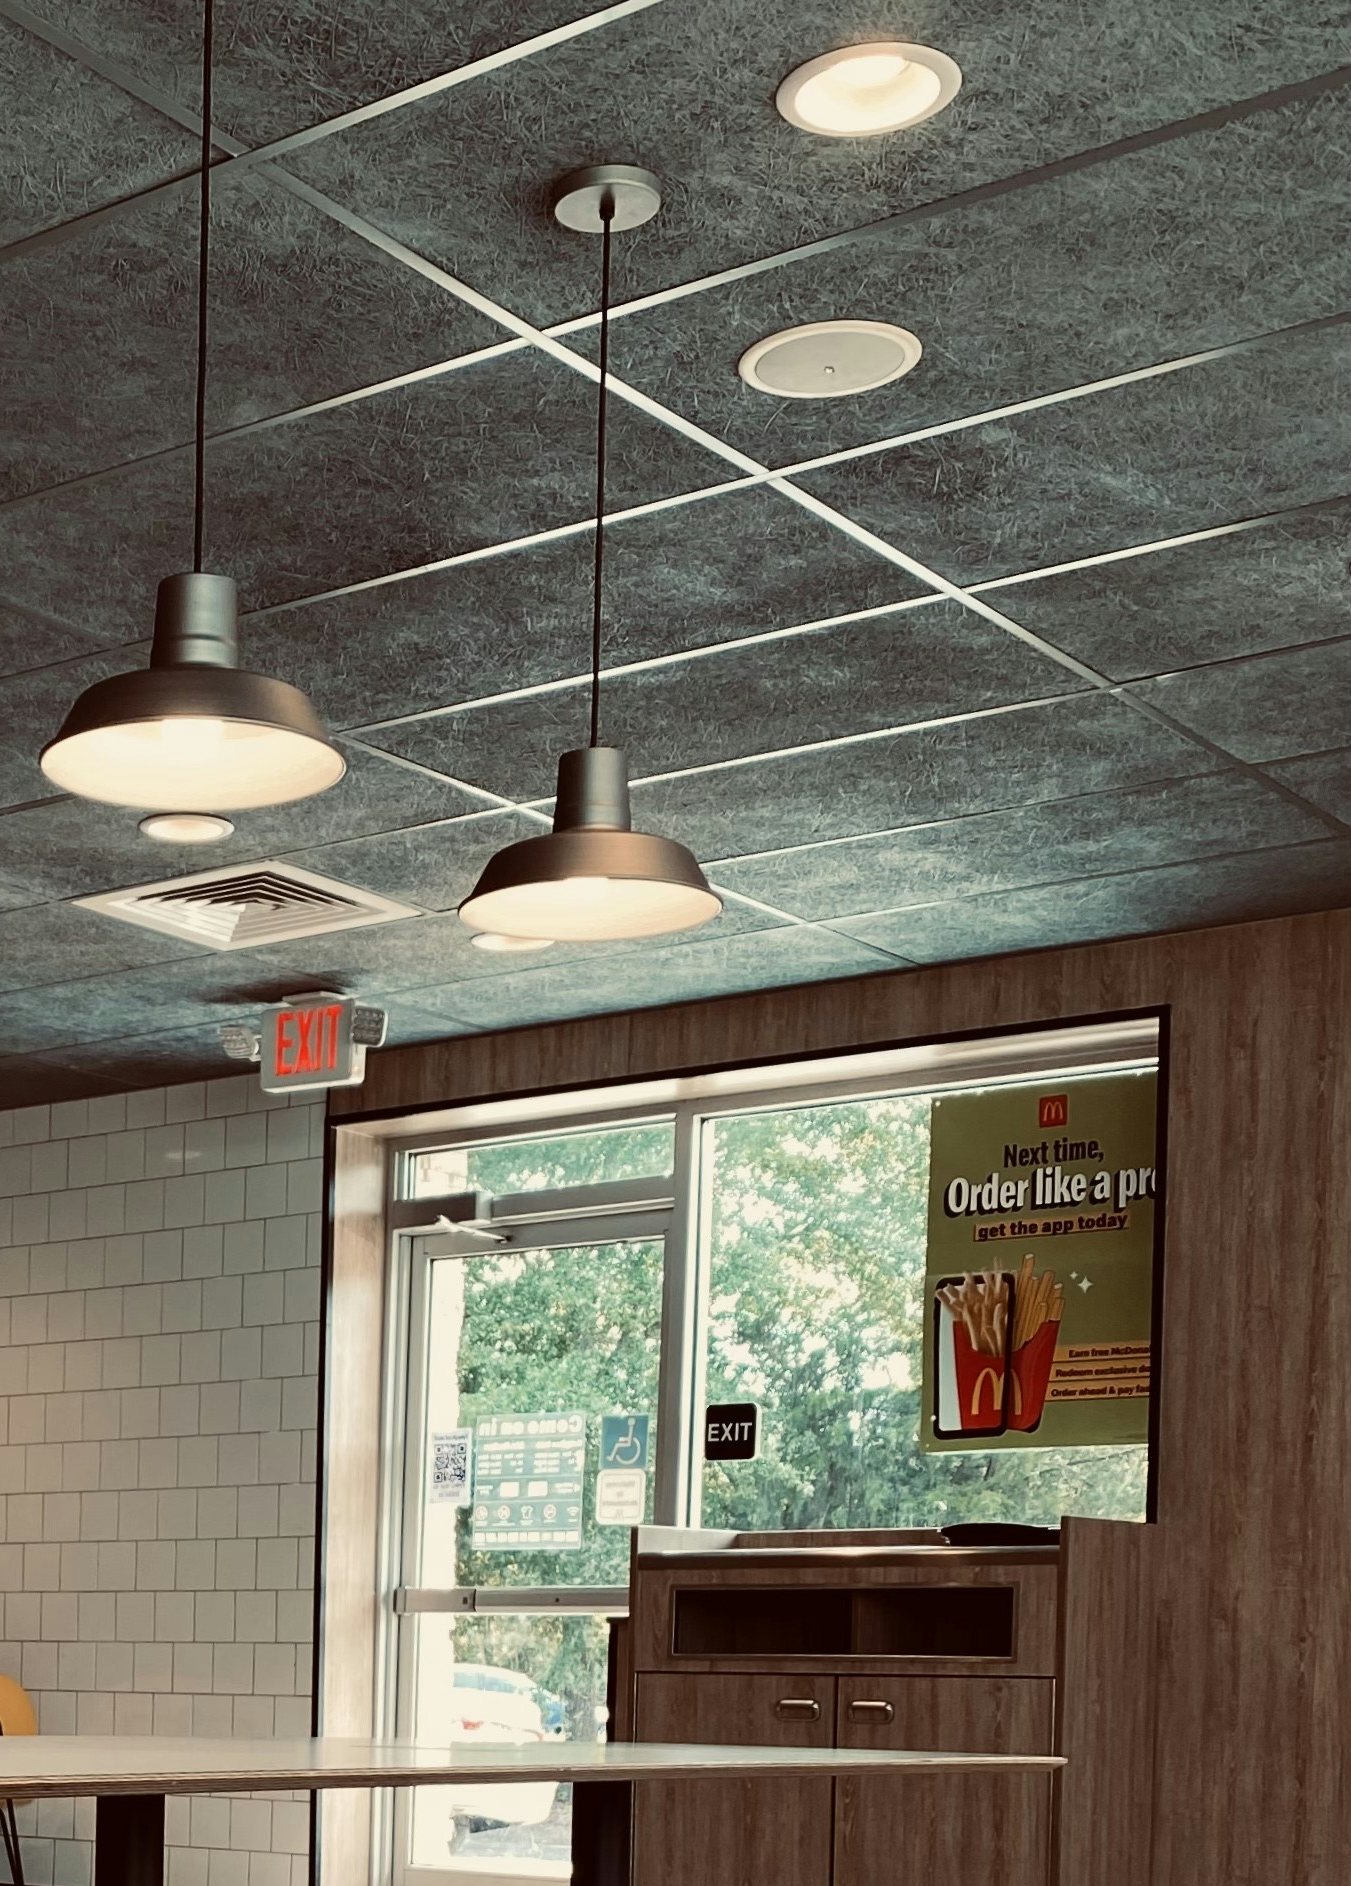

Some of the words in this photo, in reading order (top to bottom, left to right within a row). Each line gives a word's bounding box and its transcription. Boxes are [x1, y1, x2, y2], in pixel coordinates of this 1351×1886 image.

[275, 1004, 344, 1076] EXIT
[1003, 1141, 1049, 1168] Next
[1053, 1137, 1104, 1163] time,
[947, 1172, 1029, 1214] Order
[1034, 1165, 1087, 1206] like
[1093, 1170, 1111, 1200] a
[1118, 1166, 1157, 1209] pr
[977, 1223, 1006, 1241] get
[1010, 1220, 1039, 1236] the
[1042, 1218, 1074, 1235] app
[1077, 1213, 1128, 1230] today
[1051, 1388, 1077, 1397] Order
[1078, 1386, 1107, 1396] ahead
[1108, 1386, 1116, 1394] &
[1117, 1386, 1135, 1398] pay
[707, 1422, 753, 1442] EXIT
